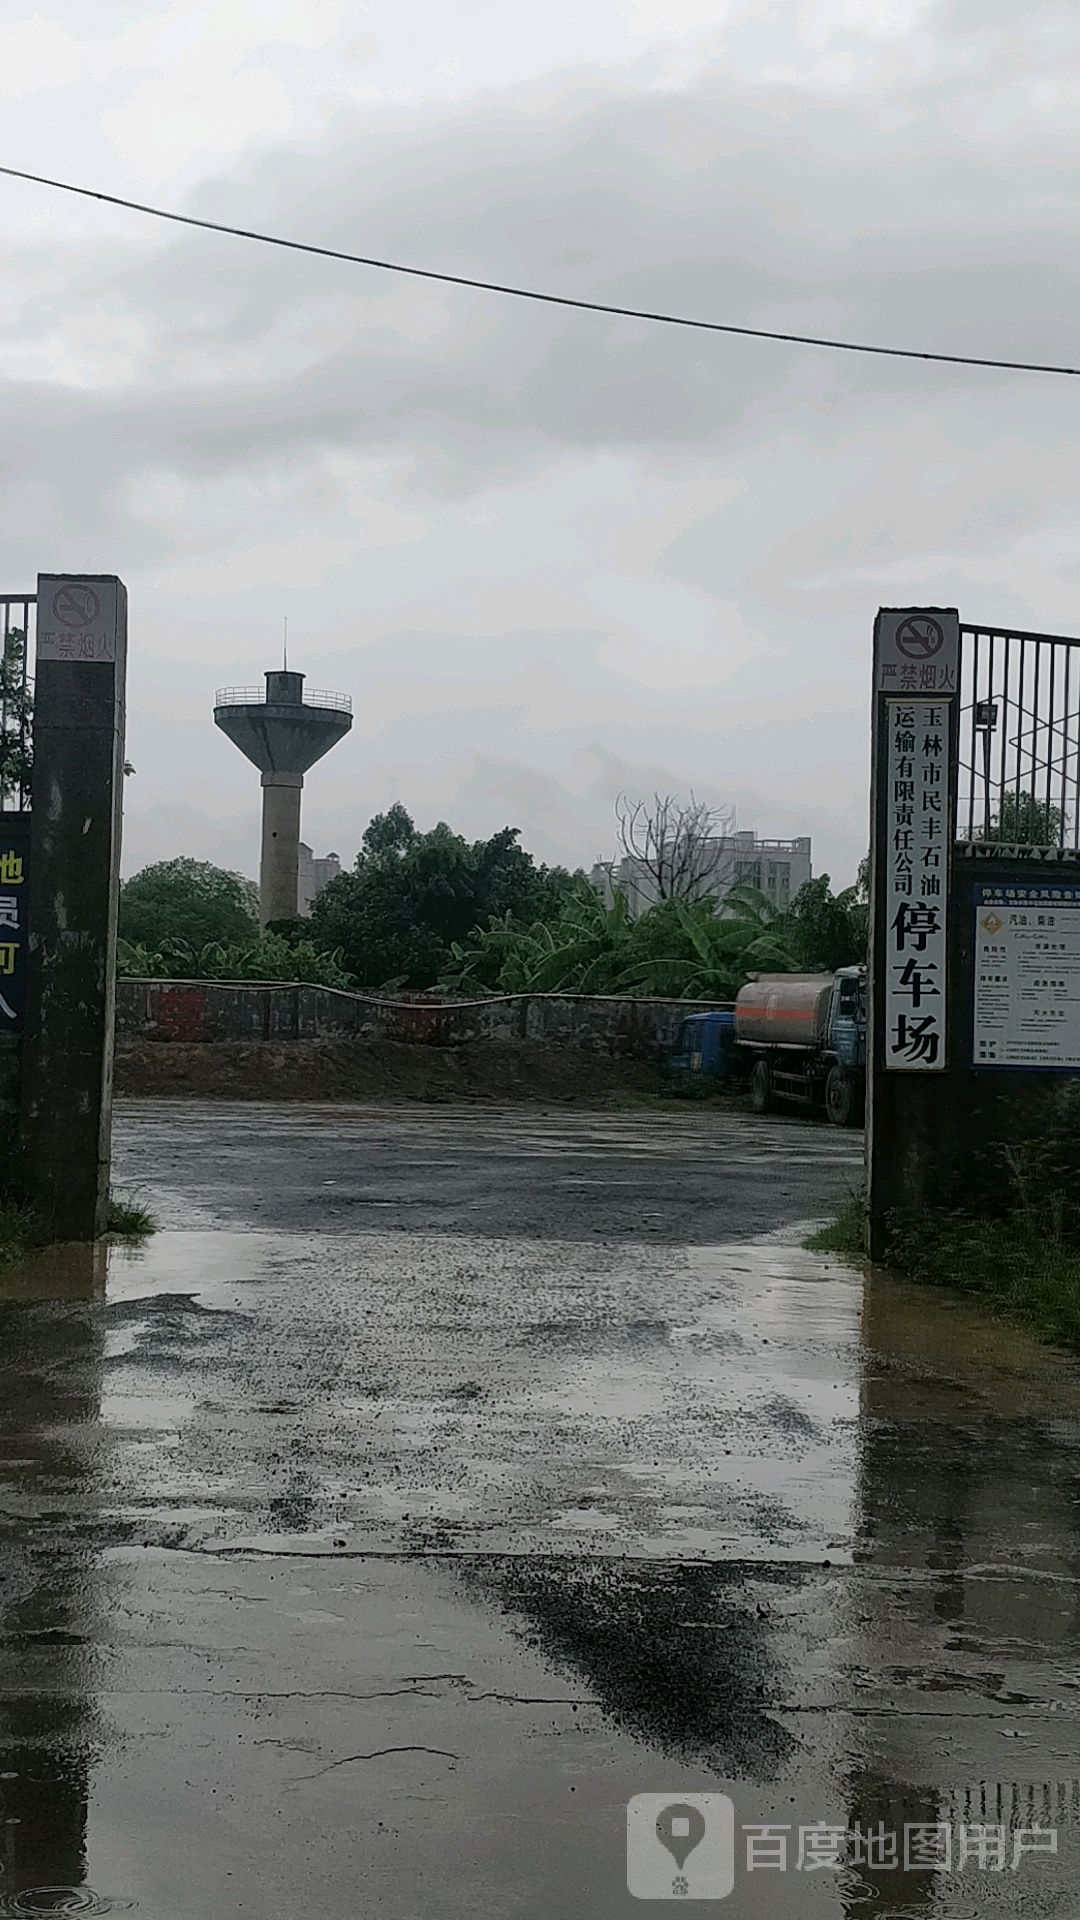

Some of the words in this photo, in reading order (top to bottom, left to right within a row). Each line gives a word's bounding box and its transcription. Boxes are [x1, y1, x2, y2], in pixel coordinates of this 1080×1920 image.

[40, 632, 113, 658] 严禁烟火
[881, 663, 955, 690] 严禁烟火
[893, 706, 916, 896] 运输有限责任公司
[920, 706, 943, 896] 玉林市民丰石油
[890, 901, 942, 1064] 停车场
